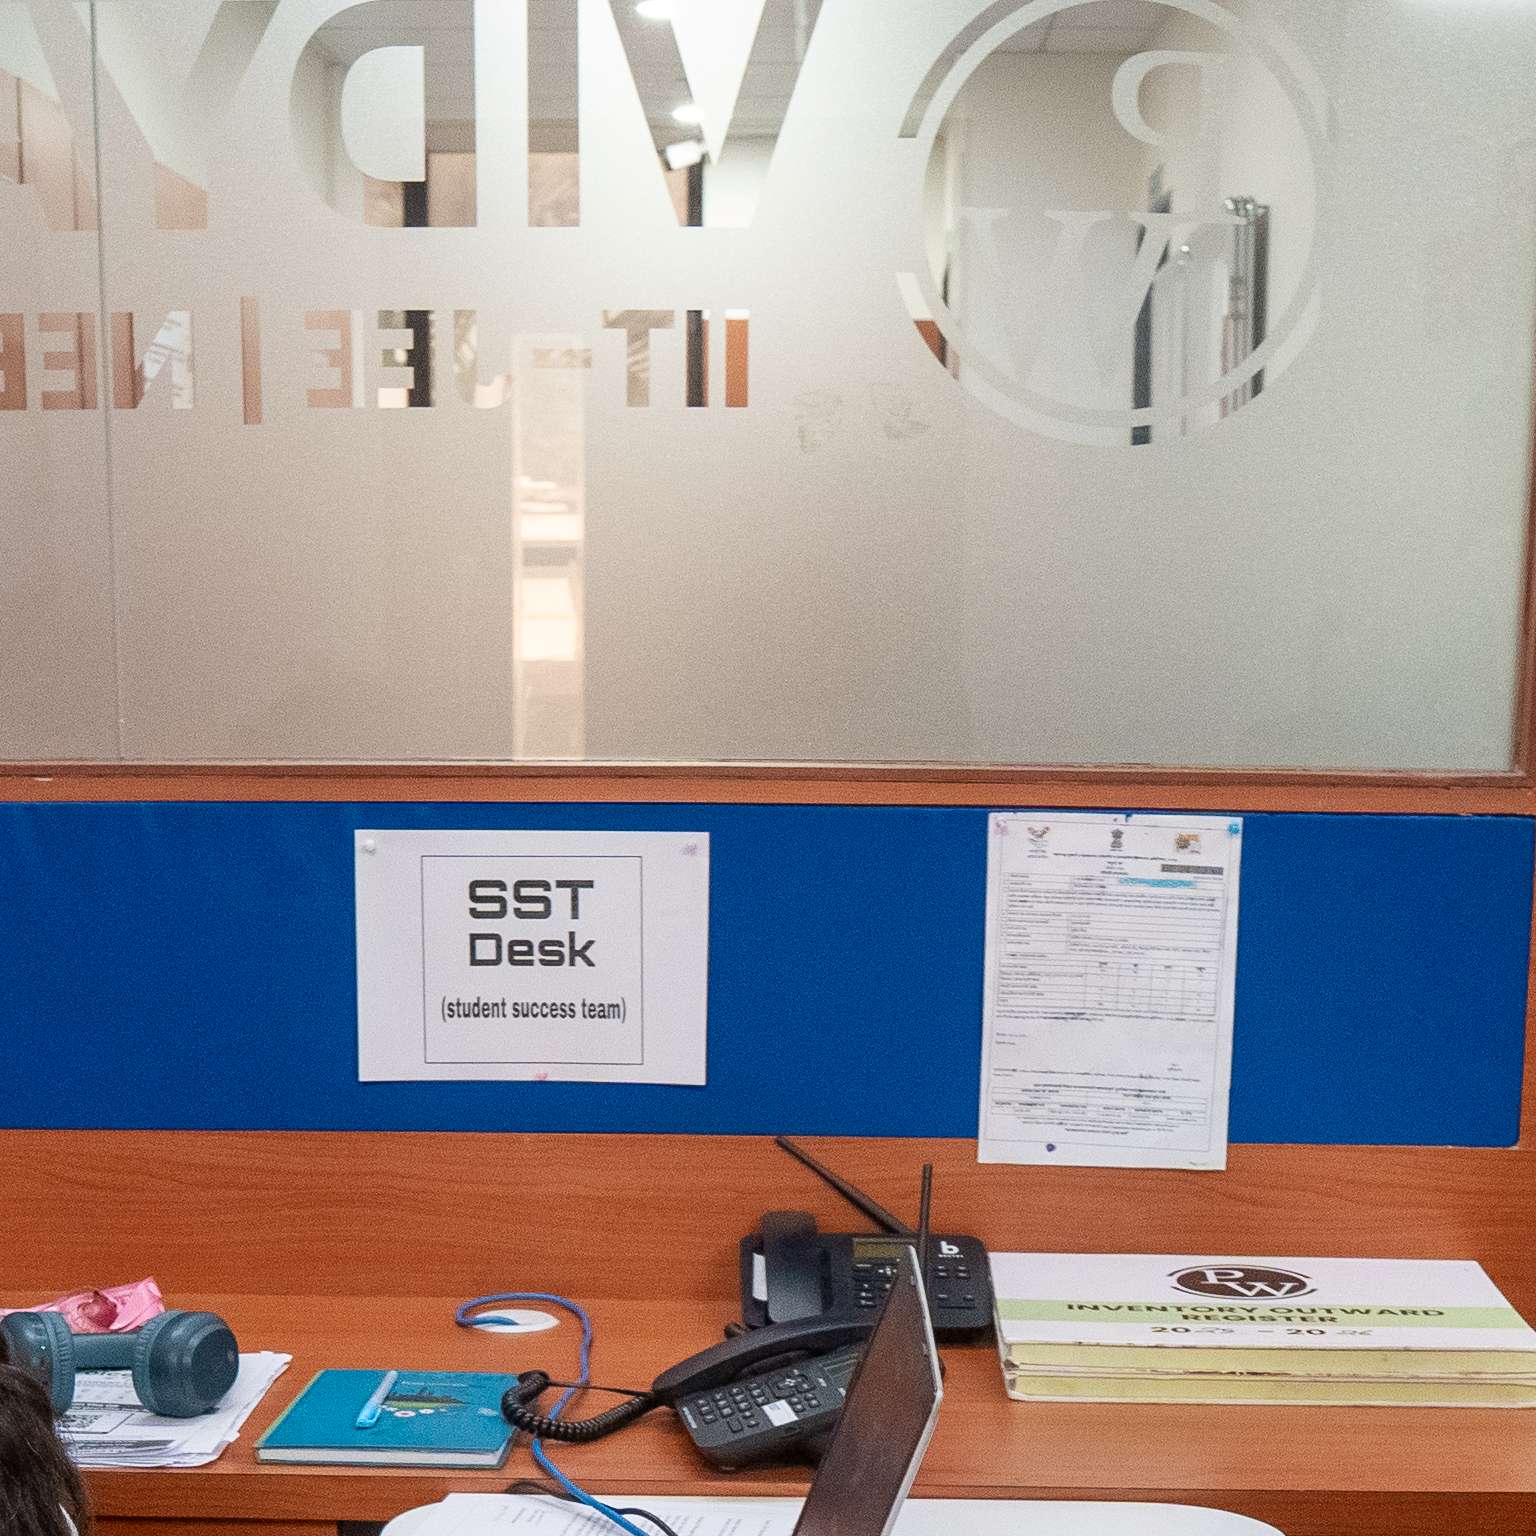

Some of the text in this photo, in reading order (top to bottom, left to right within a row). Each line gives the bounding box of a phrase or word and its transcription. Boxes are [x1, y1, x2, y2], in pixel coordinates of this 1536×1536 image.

[468, 879, 594, 920] SST
[469, 931, 596, 968] Desk
[441, 996, 626, 1023] (student success team)
[1202, 1268, 1299, 1297] PW
[1066, 1303, 1445, 1317] INVENTORY OUTWARD
[1181, 1313, 1338, 1323] REGISTER
